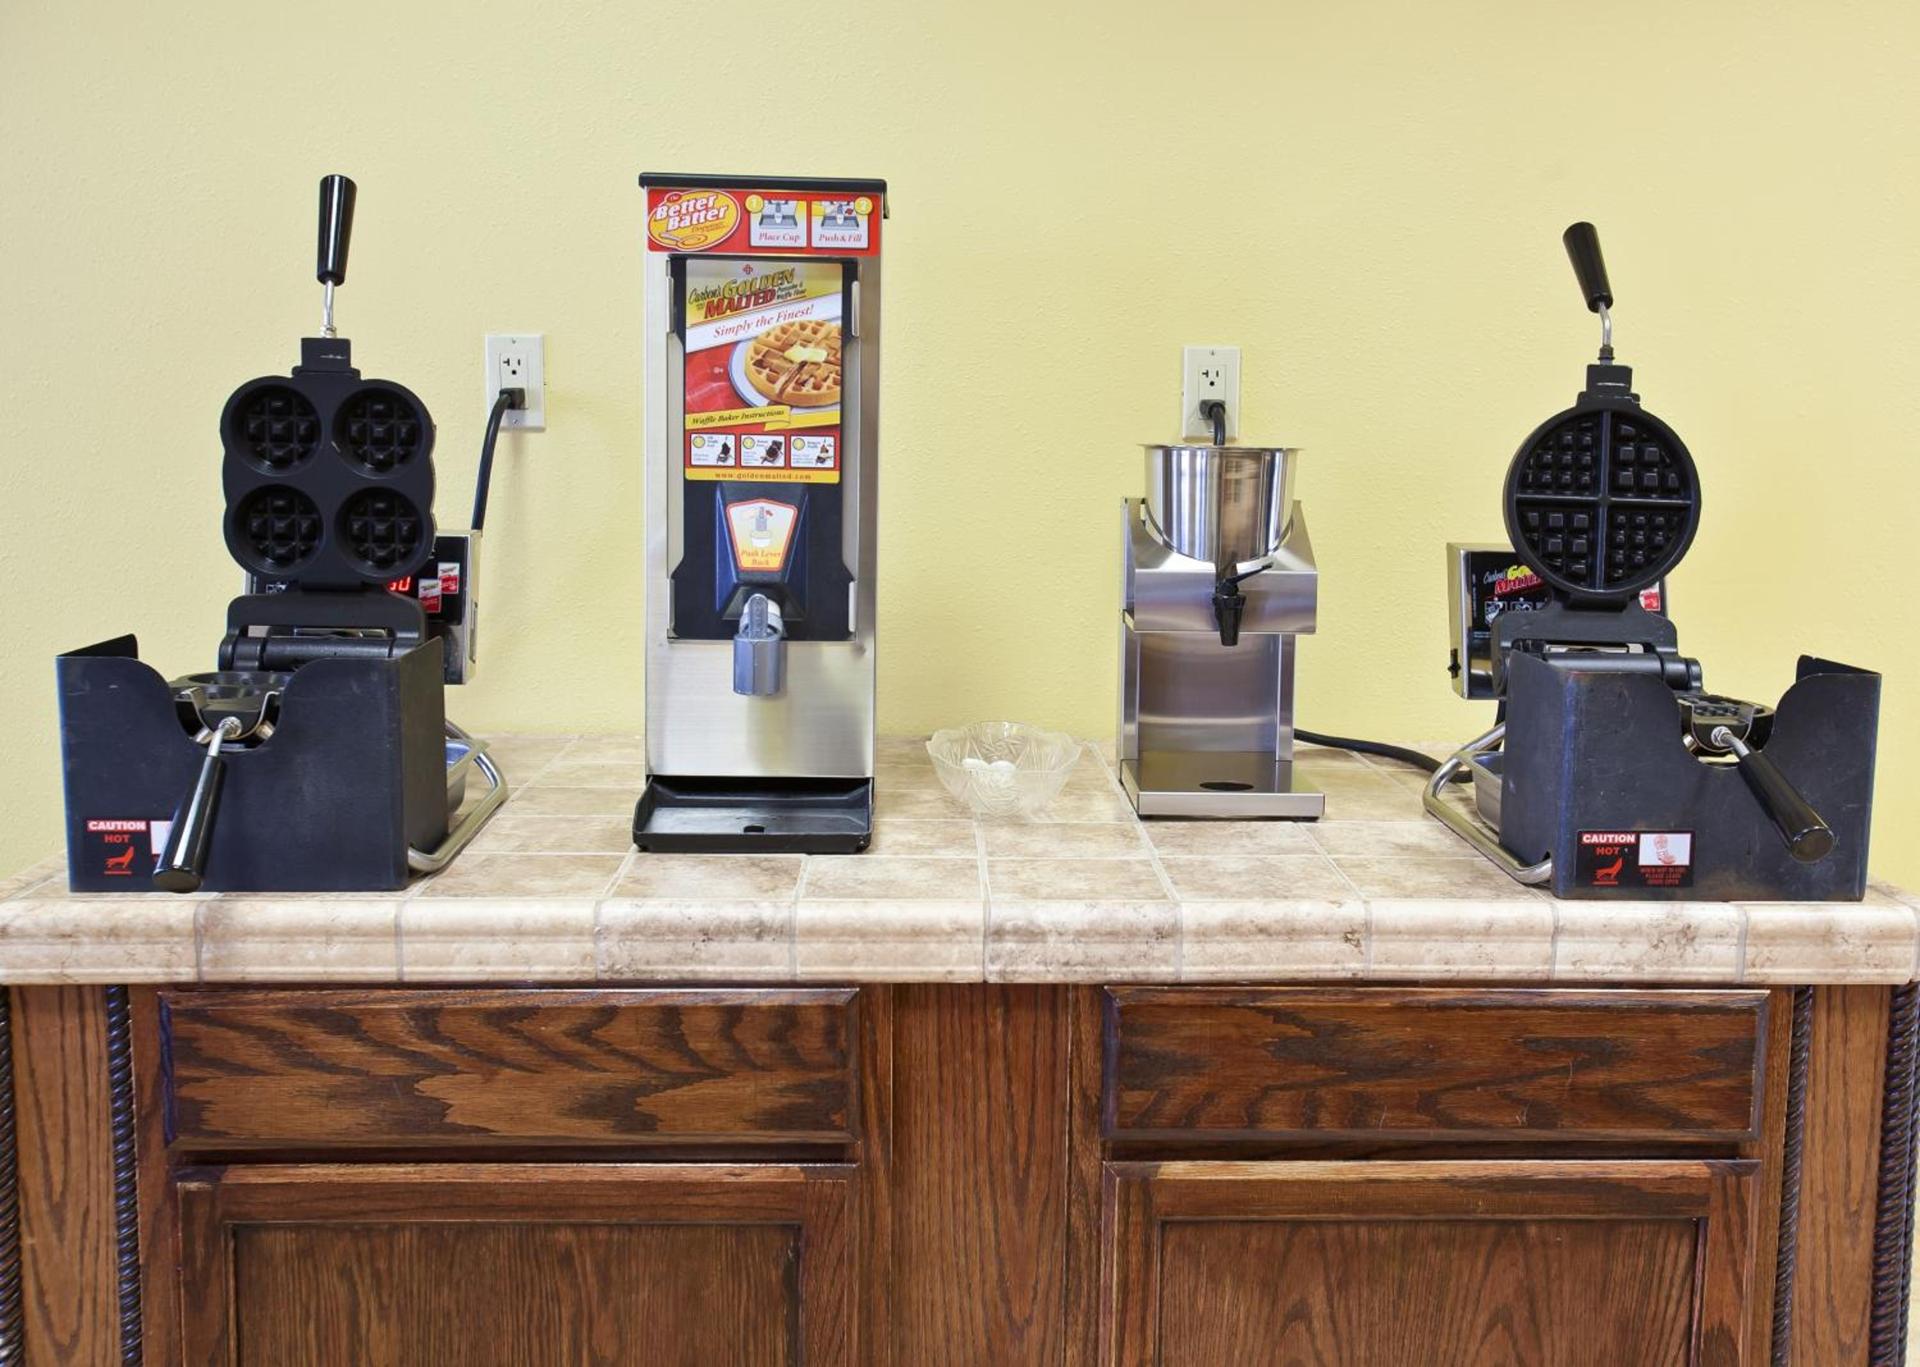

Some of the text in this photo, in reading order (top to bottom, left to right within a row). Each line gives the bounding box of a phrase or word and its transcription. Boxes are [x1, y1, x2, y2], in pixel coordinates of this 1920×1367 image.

[656, 194, 717, 220] Better
[667, 205, 728, 231] Batter
[759, 232, 800, 242] Place Cup
[819, 233, 838, 242] Push
[847, 233, 862, 242] Fill
[723, 267, 795, 299] GOLDEN
[704, 287, 776, 319] MALTED
[713, 304, 814, 338] Simply the Finest!
[692, 410, 784, 425] Waffle Baker Instructions
[741, 549, 759, 557] Push
[88, 820, 146, 831] CAUTION
[104, 834, 130, 843] HOT
[1582, 833, 1636, 844] CAUTION
[1595, 846, 1620, 855] HOT
